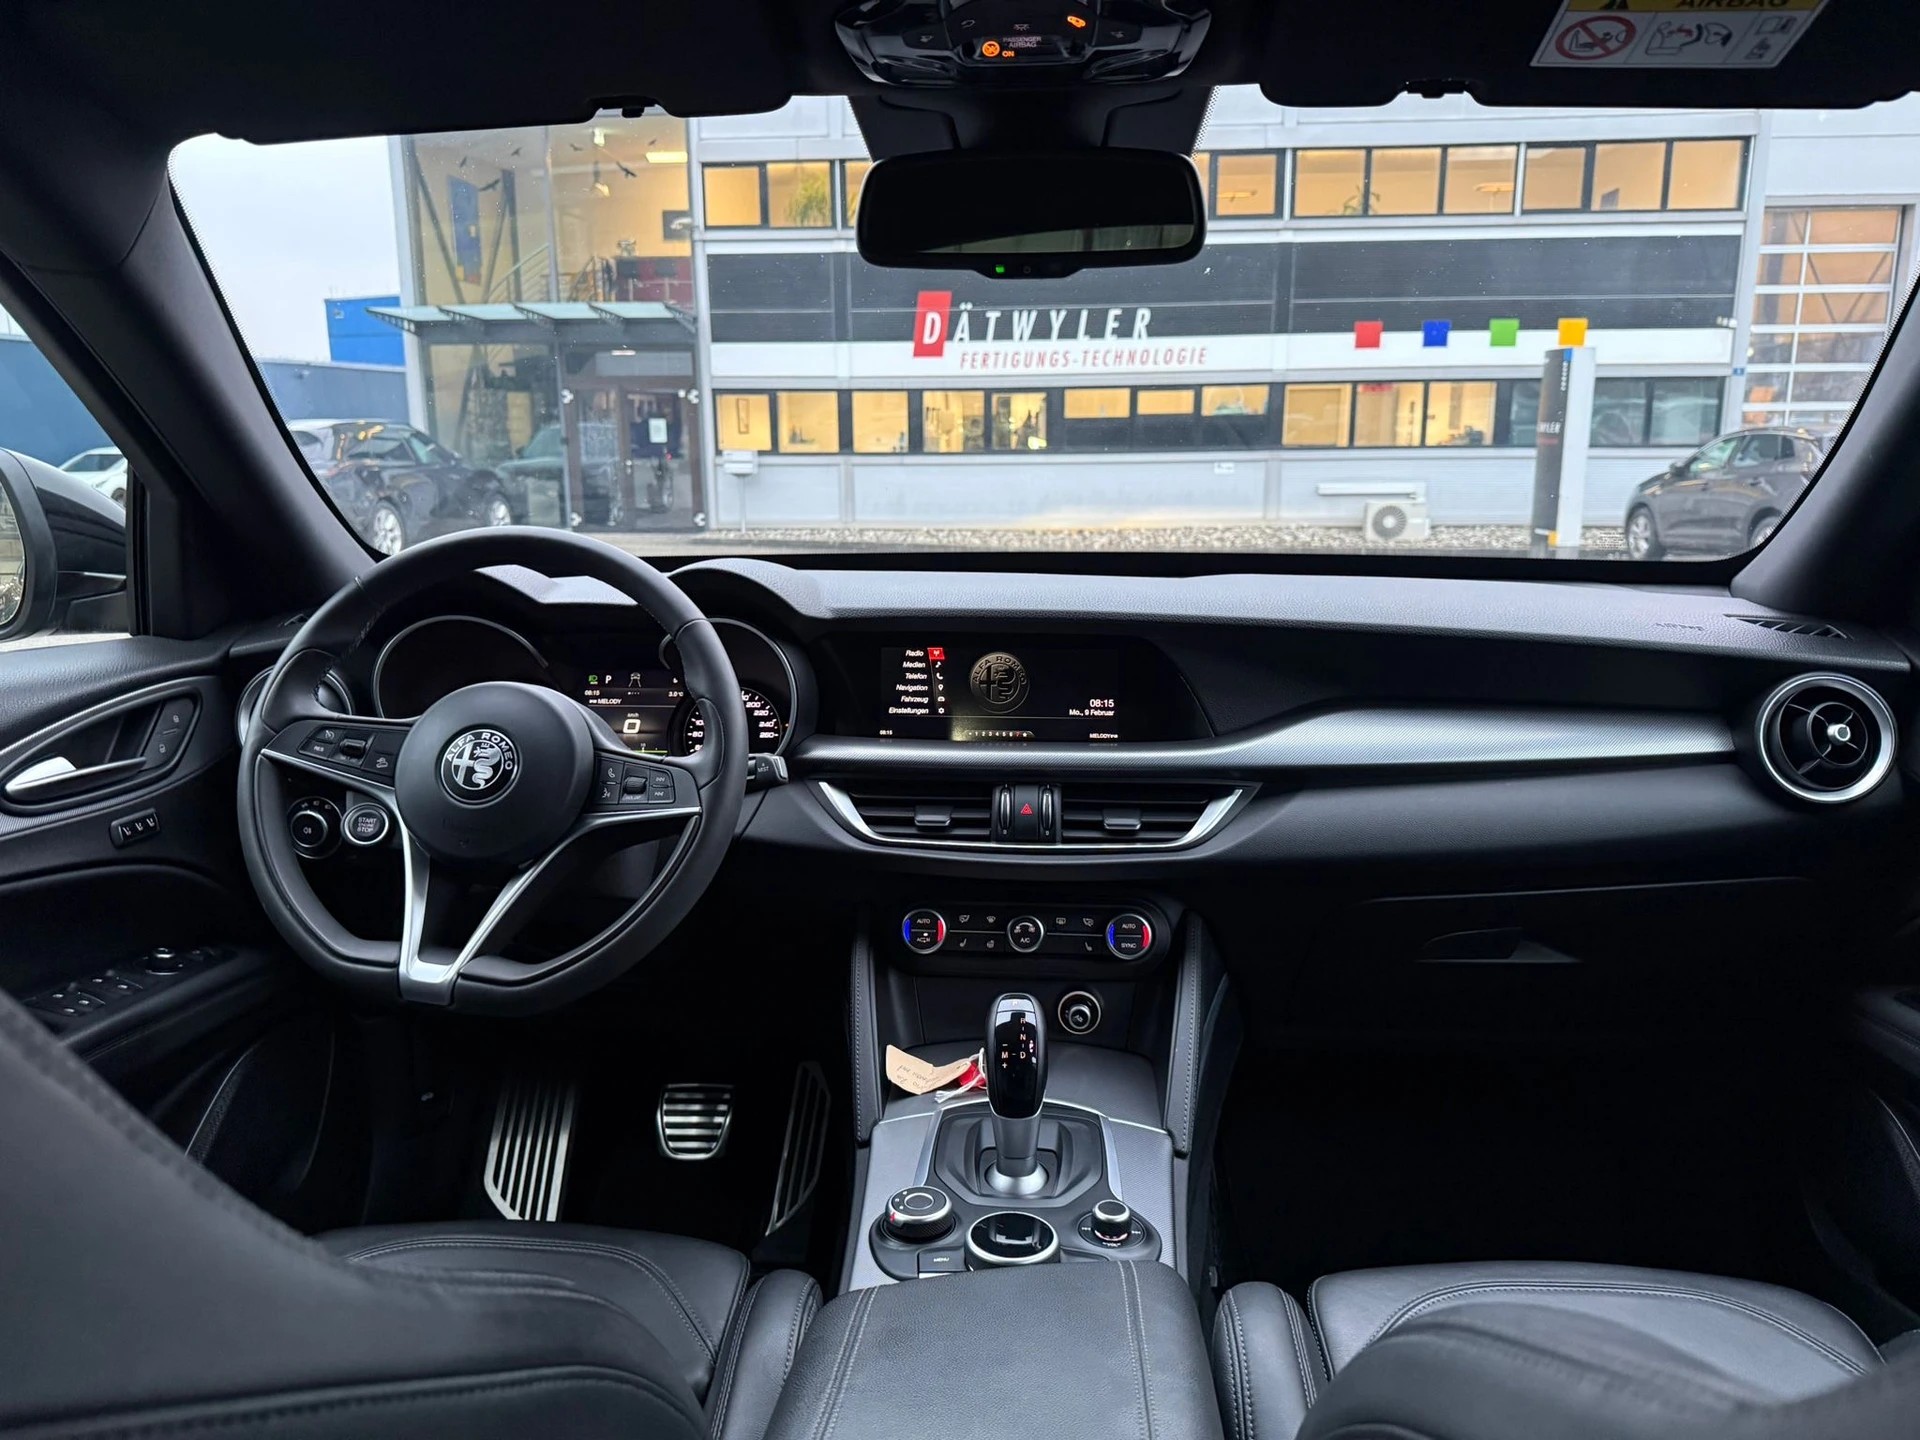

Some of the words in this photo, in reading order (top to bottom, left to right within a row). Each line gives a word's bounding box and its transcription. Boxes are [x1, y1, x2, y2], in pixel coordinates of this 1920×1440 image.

[922, 302, 1151, 345] DÄTWYLER
[960, 346, 1208, 370] FERTIGUNGS-TECHNOLOGIE
[905, 649, 924, 657] Radio
[605, 675, 612, 684] P
[896, 684, 928, 692] Navigation
[900, 696, 929, 704] Fahrzeug
[1089, 699, 1115, 708] 08:15
[888, 707, 929, 715] Einstellungen
[622, 719, 641, 734] 0
[446, 734, 475, 762] ALFA
[481, 732, 513, 770] ROMEO
[1020, 1033, 1026, 1041] N
[1001, 1051, 1009, 1059] M
[1020, 1051, 1026, 1059] D
